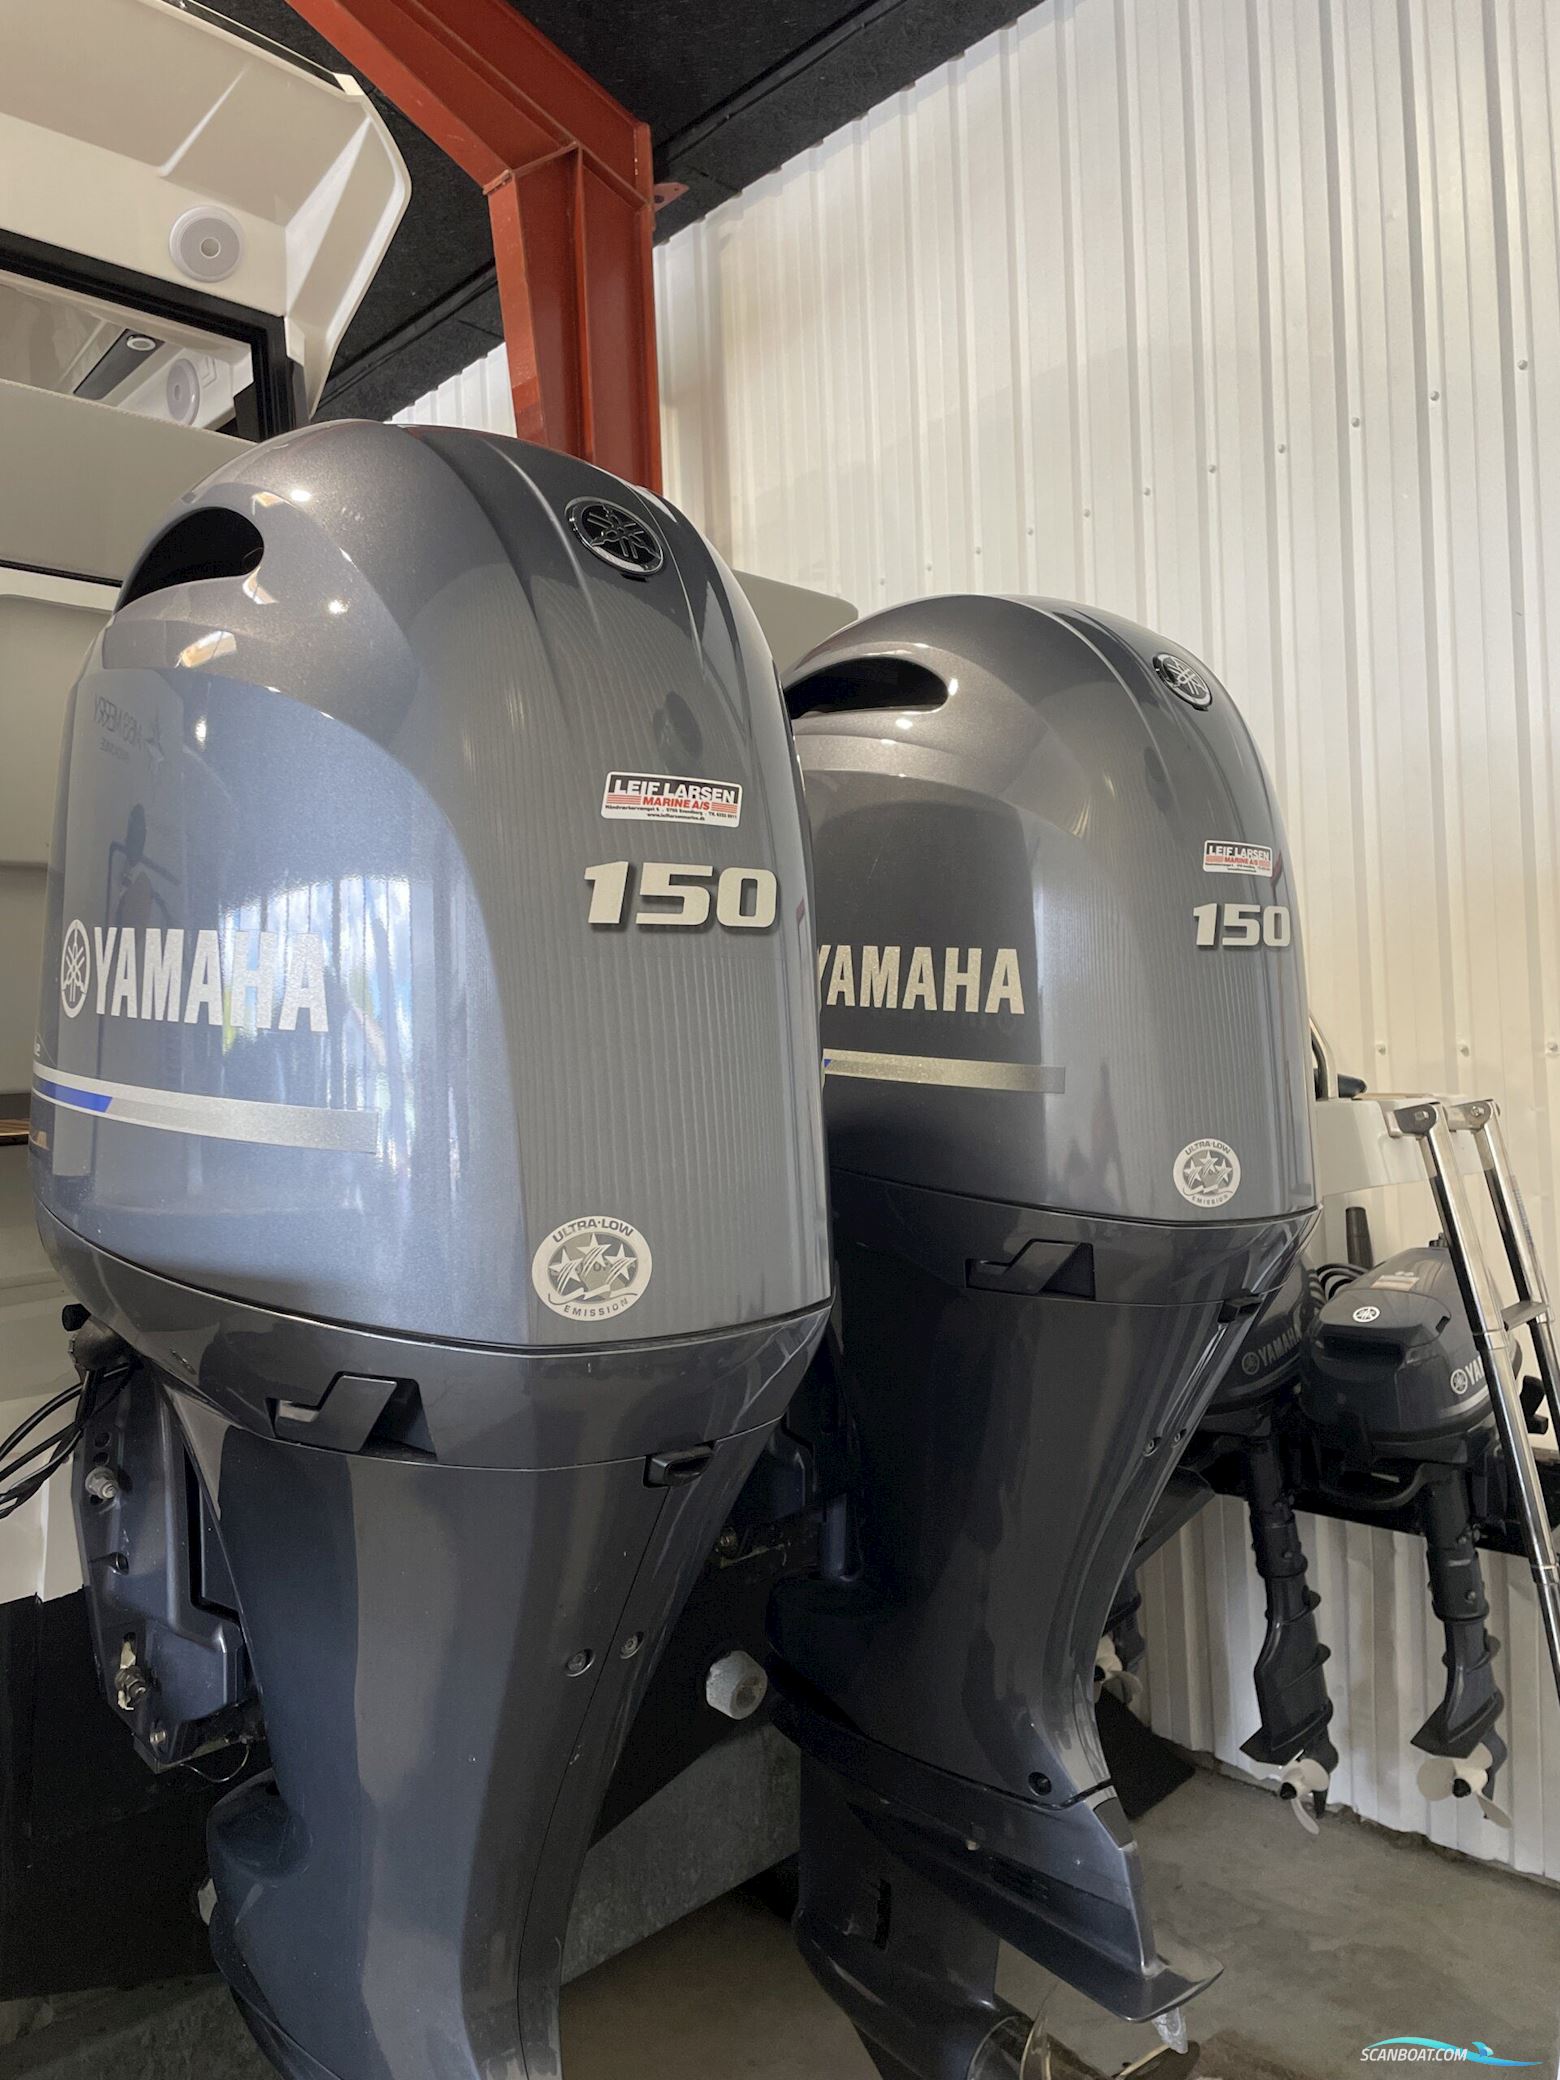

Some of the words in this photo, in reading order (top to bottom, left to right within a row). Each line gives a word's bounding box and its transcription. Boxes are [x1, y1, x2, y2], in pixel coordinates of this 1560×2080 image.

[613, 779, 660, 796] LEIF
[663, 783, 736, 804] LARSEN
[642, 796, 690, 809] MARINE
[692, 800, 710, 811] A/S
[1208, 845, 1234, 857] LEIF
[1234, 847, 1270, 861] LARSEN
[1224, 856, 1249, 864] MARINE
[584, 861, 778, 928] 150
[1193, 902, 1291, 947] 150
[93, 926, 329, 1033] YAMAHA
[563, 1297, 629, 1317] EMISSION
